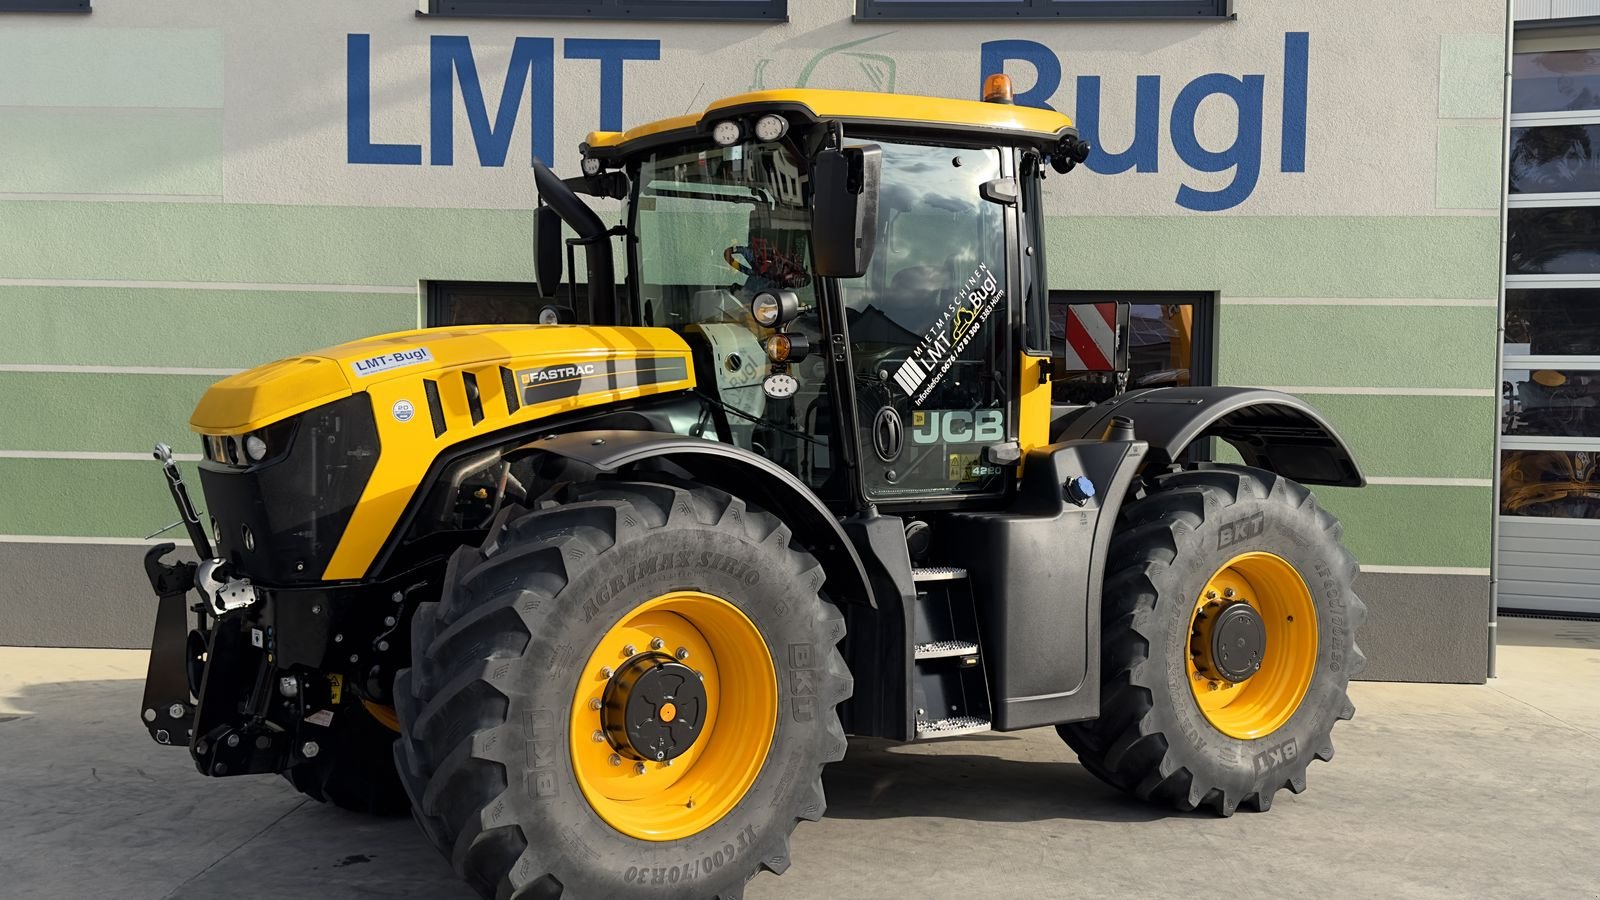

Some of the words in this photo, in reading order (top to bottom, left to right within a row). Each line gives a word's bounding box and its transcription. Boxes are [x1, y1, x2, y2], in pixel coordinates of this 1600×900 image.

[346, 33, 661, 168] LMT
[980, 31, 1310, 212] Bugl
[913, 262, 987, 357] MIETMASCHINEN
[920, 330, 951, 372] LMT
[968, 269, 998, 310] Bugl
[355, 347, 427, 371] LMT-Bugl
[529, 364, 595, 383] FASTRAC
[914, 371, 944, 406] Infotelefon:
[941, 354, 956, 374] 0676
[980, 305, 992, 322] 3383
[913, 410, 1004, 444] JCB
[1219, 512, 1264, 548] BKT
[583, 553, 690, 624] AGRIMAX
[696, 551, 760, 586] SIRIO
[795, 645, 818, 721] BKT
[528, 712, 557, 798] BKT
[1255, 739, 1297, 776] BKT
